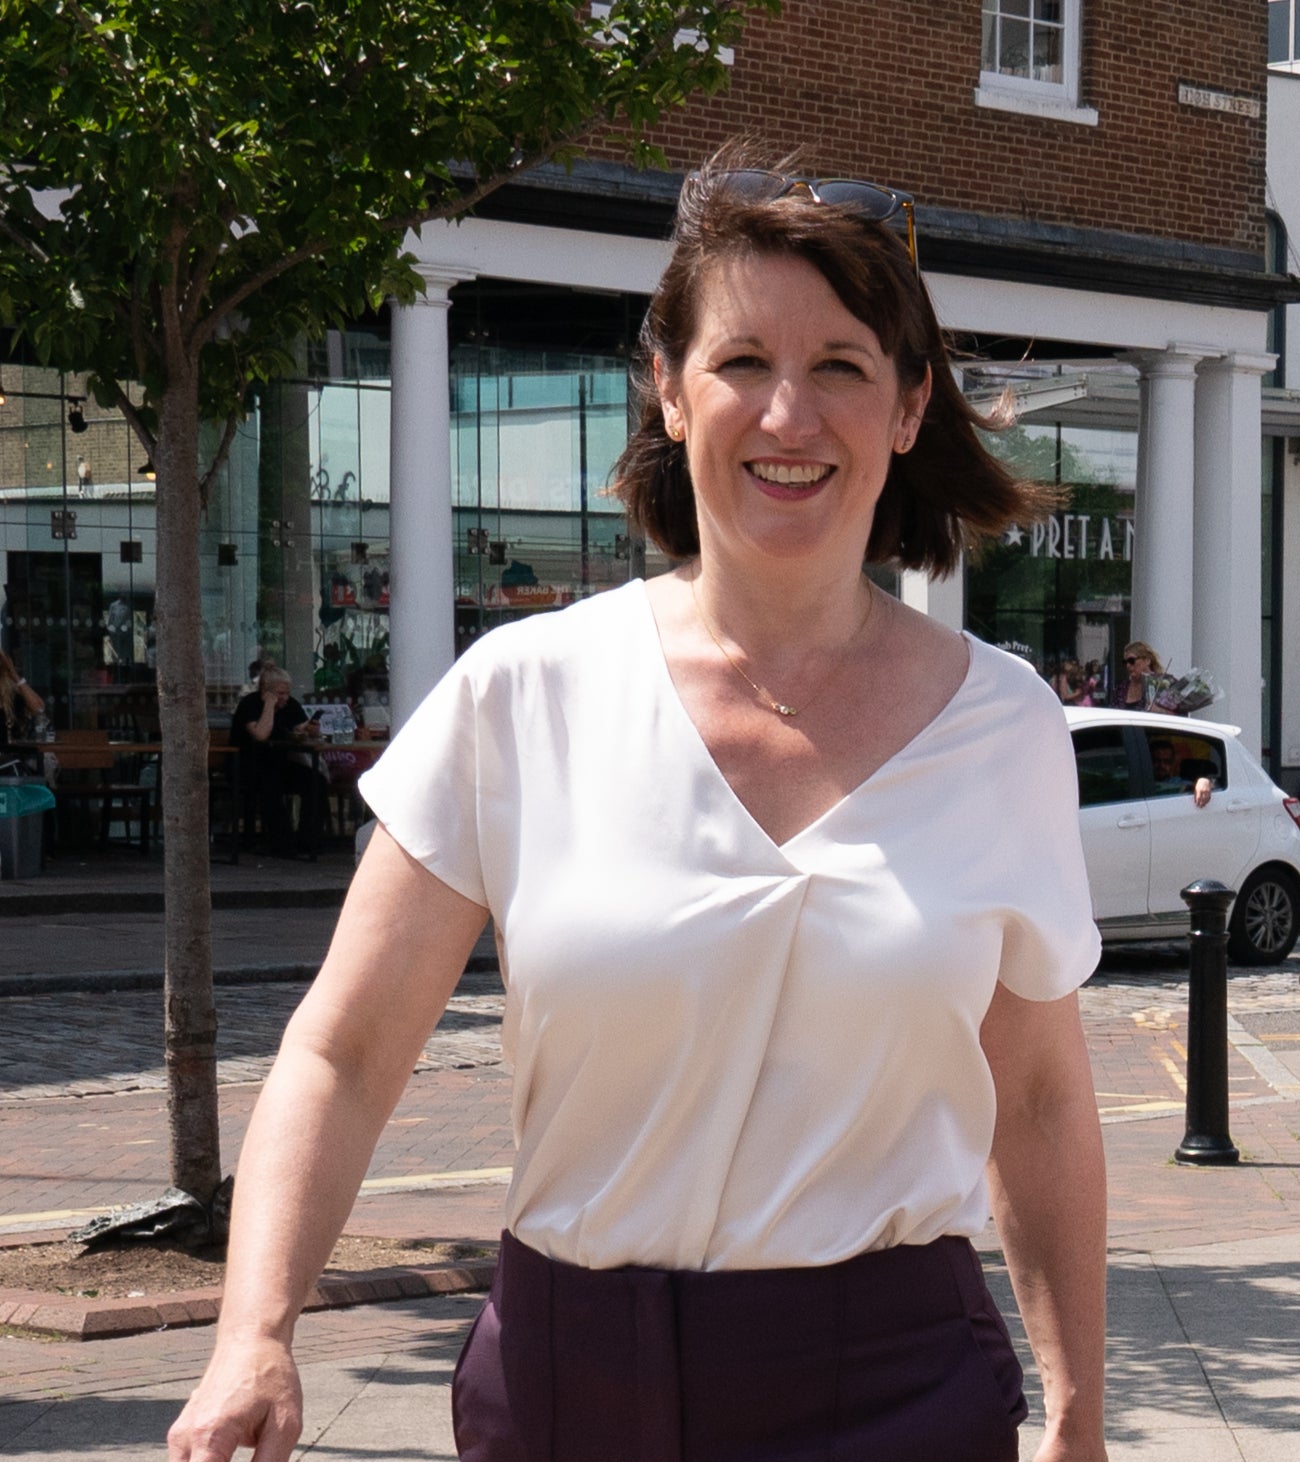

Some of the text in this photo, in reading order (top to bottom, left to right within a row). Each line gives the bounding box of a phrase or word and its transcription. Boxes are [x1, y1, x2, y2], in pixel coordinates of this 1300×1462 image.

[1213, 94, 1260, 116] STREET
[1031, 514, 1090, 559] PRET
[1100, 517, 1114, 561] A
